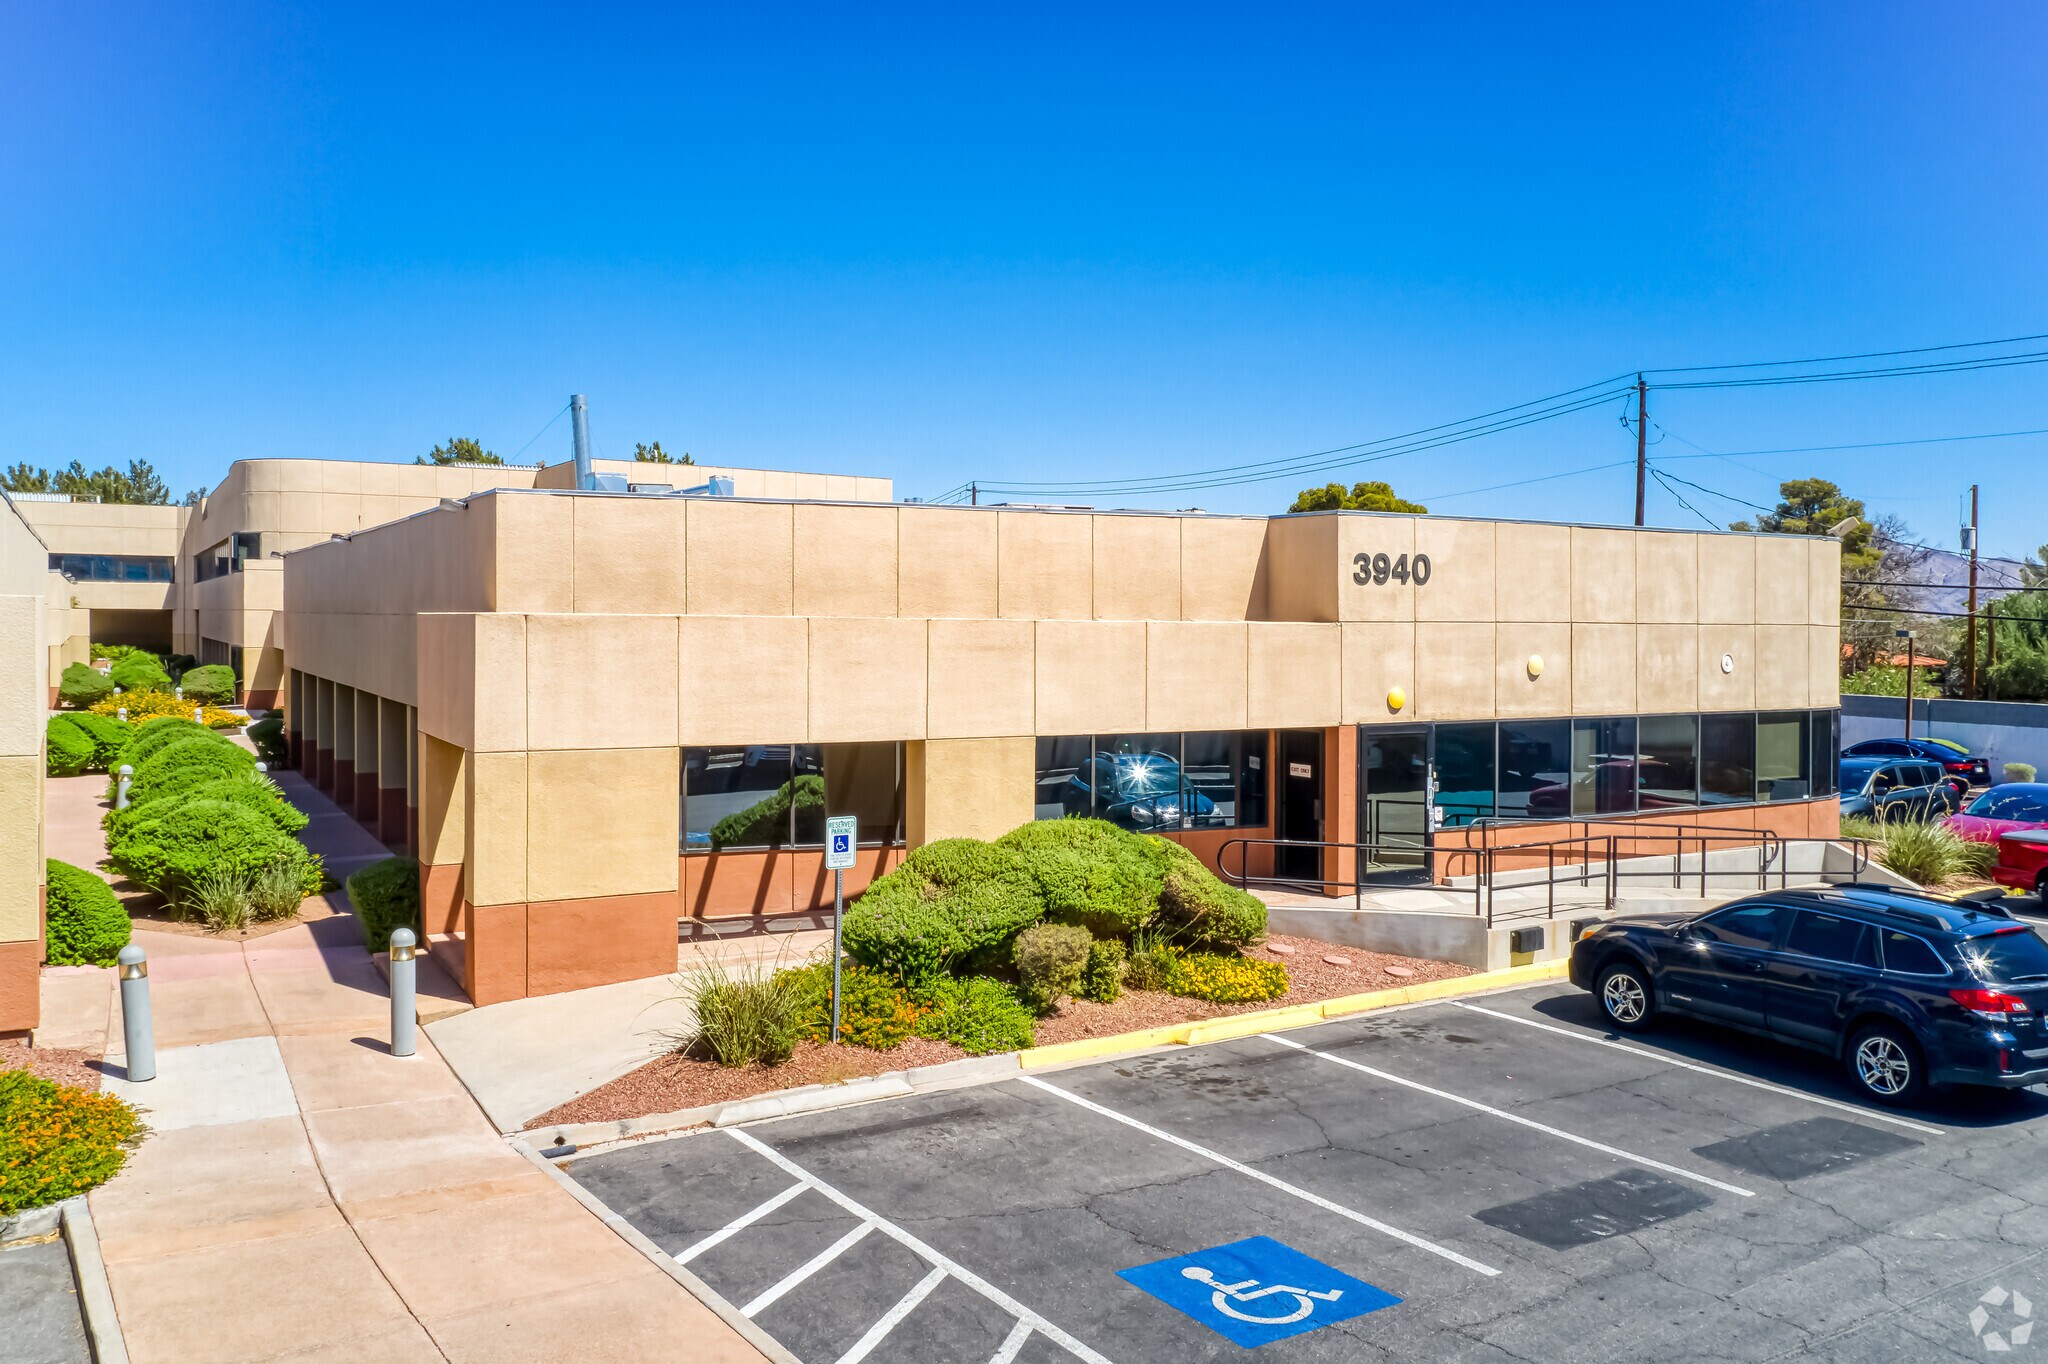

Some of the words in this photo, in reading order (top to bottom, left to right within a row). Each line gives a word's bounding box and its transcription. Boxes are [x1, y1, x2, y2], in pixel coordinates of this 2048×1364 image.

[1353, 552, 1431, 586] 3940
[828, 820, 855, 829] RESERVED
[831, 827, 852, 835] PARKING
